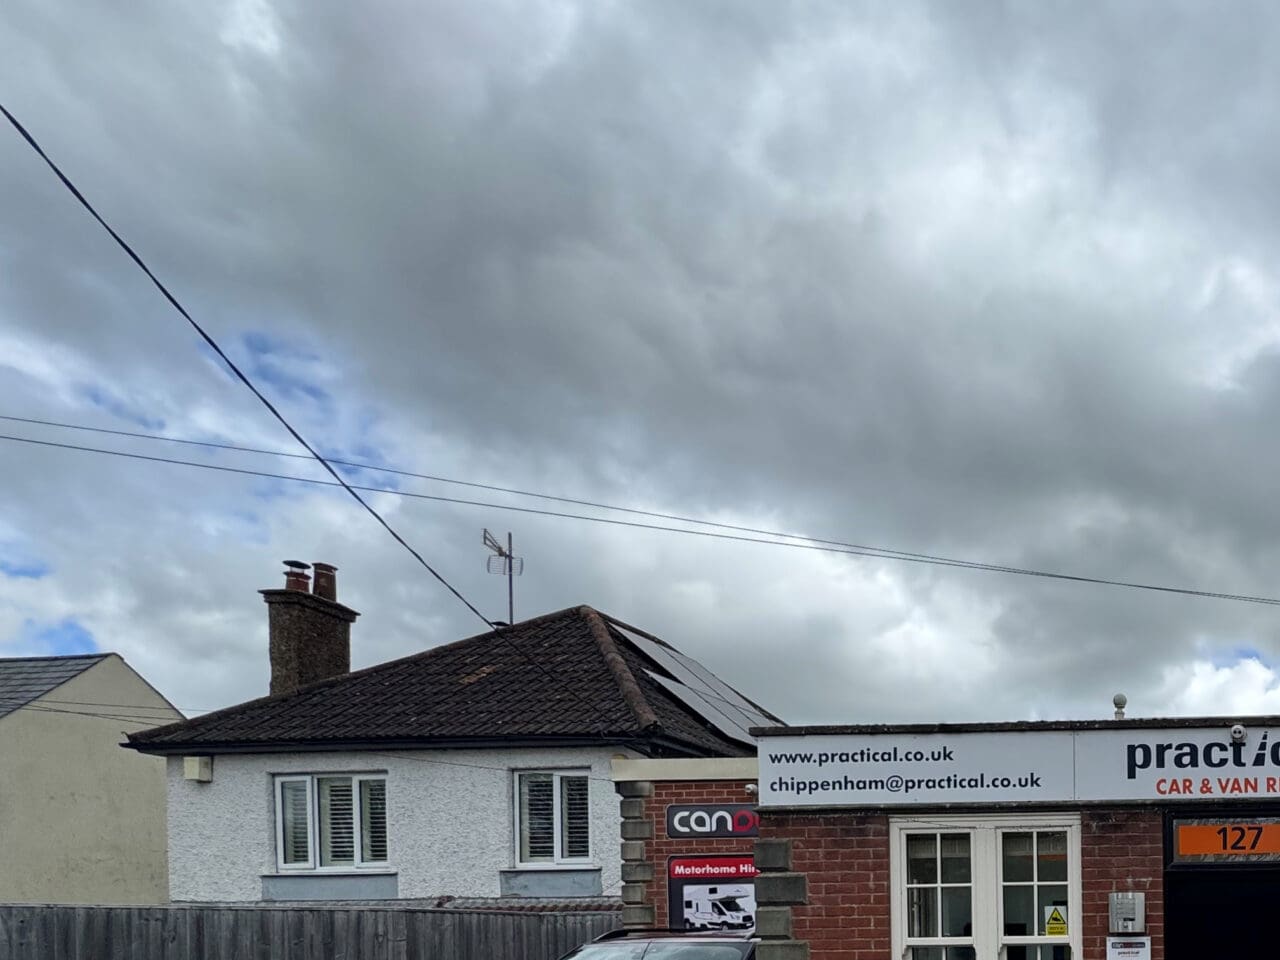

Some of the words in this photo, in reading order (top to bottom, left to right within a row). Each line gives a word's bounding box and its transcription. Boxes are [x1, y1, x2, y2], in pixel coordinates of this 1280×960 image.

[769, 746, 954, 767] www.practical.co.uk
[769, 772, 1041, 796] chippenham@practical.co.uk
[1156, 778, 1193, 795] CAR
[1199, 778, 1213, 794] &
[1217, 777, 1258, 794] VAN
[1216, 826, 1263, 851] 127
[674, 864, 737, 875] Motorhome
